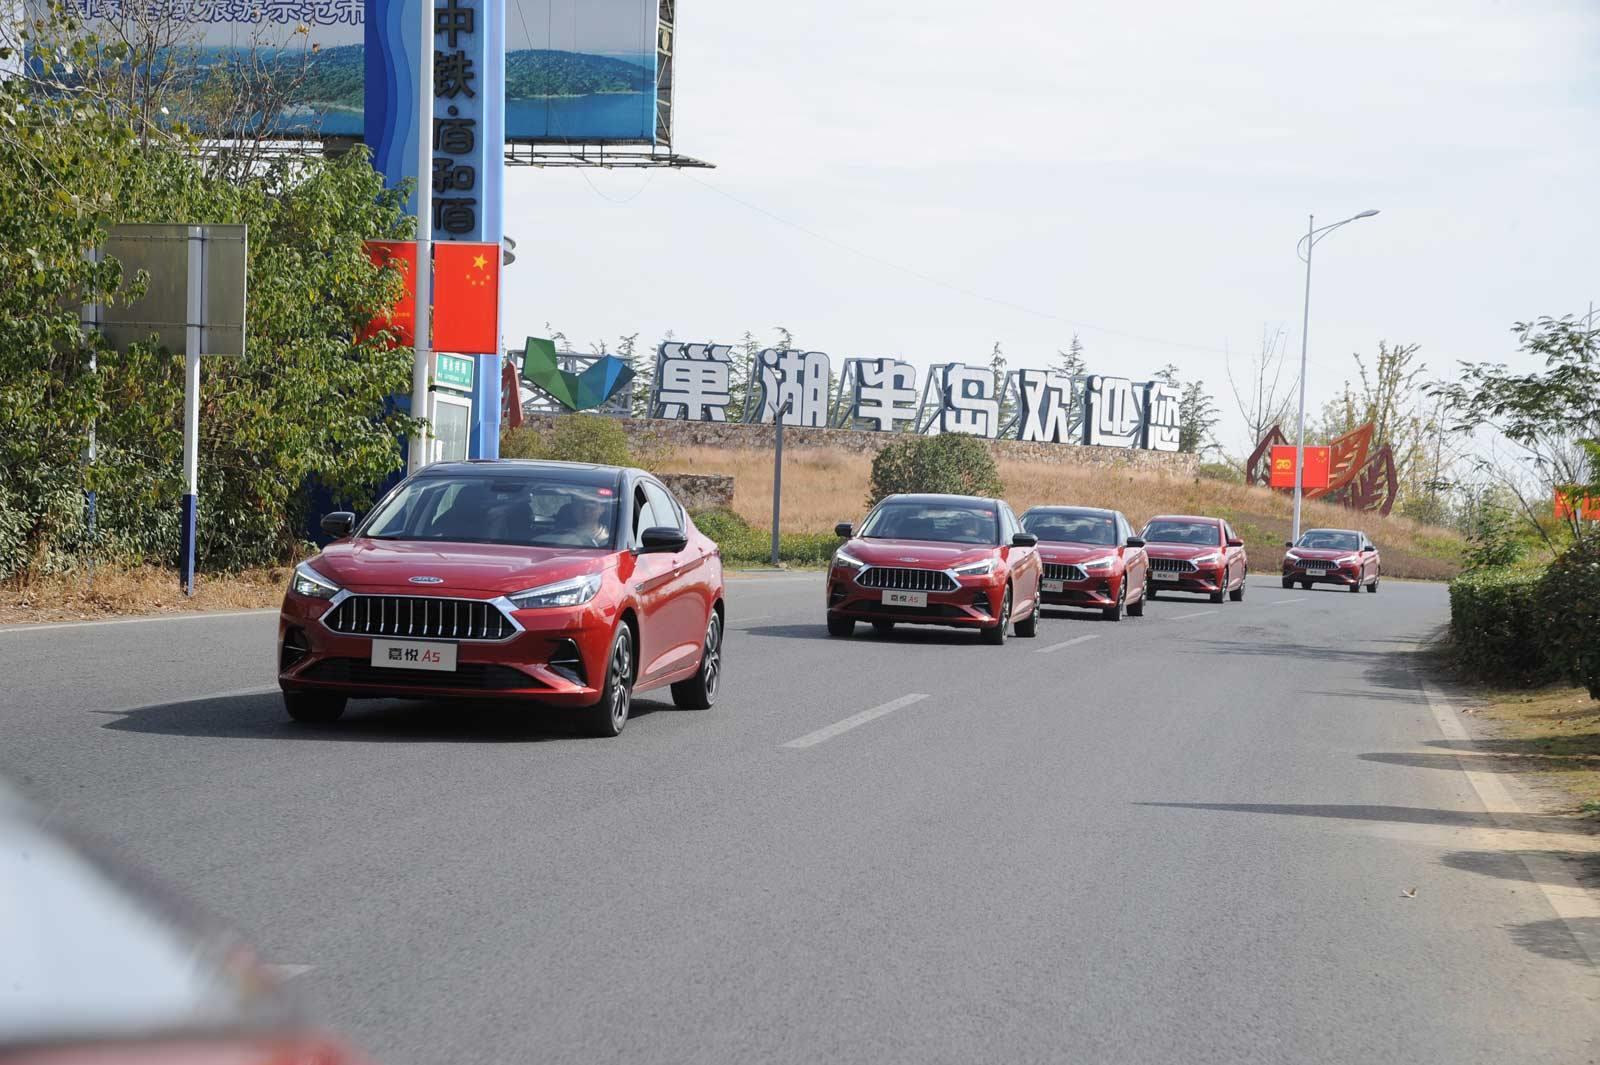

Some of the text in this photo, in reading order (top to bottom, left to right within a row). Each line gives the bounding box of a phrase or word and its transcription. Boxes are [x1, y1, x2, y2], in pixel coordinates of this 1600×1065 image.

[658, 341, 1180, 452] 巢湖半岛欢迎您
[421, 650, 441, 663] A5
